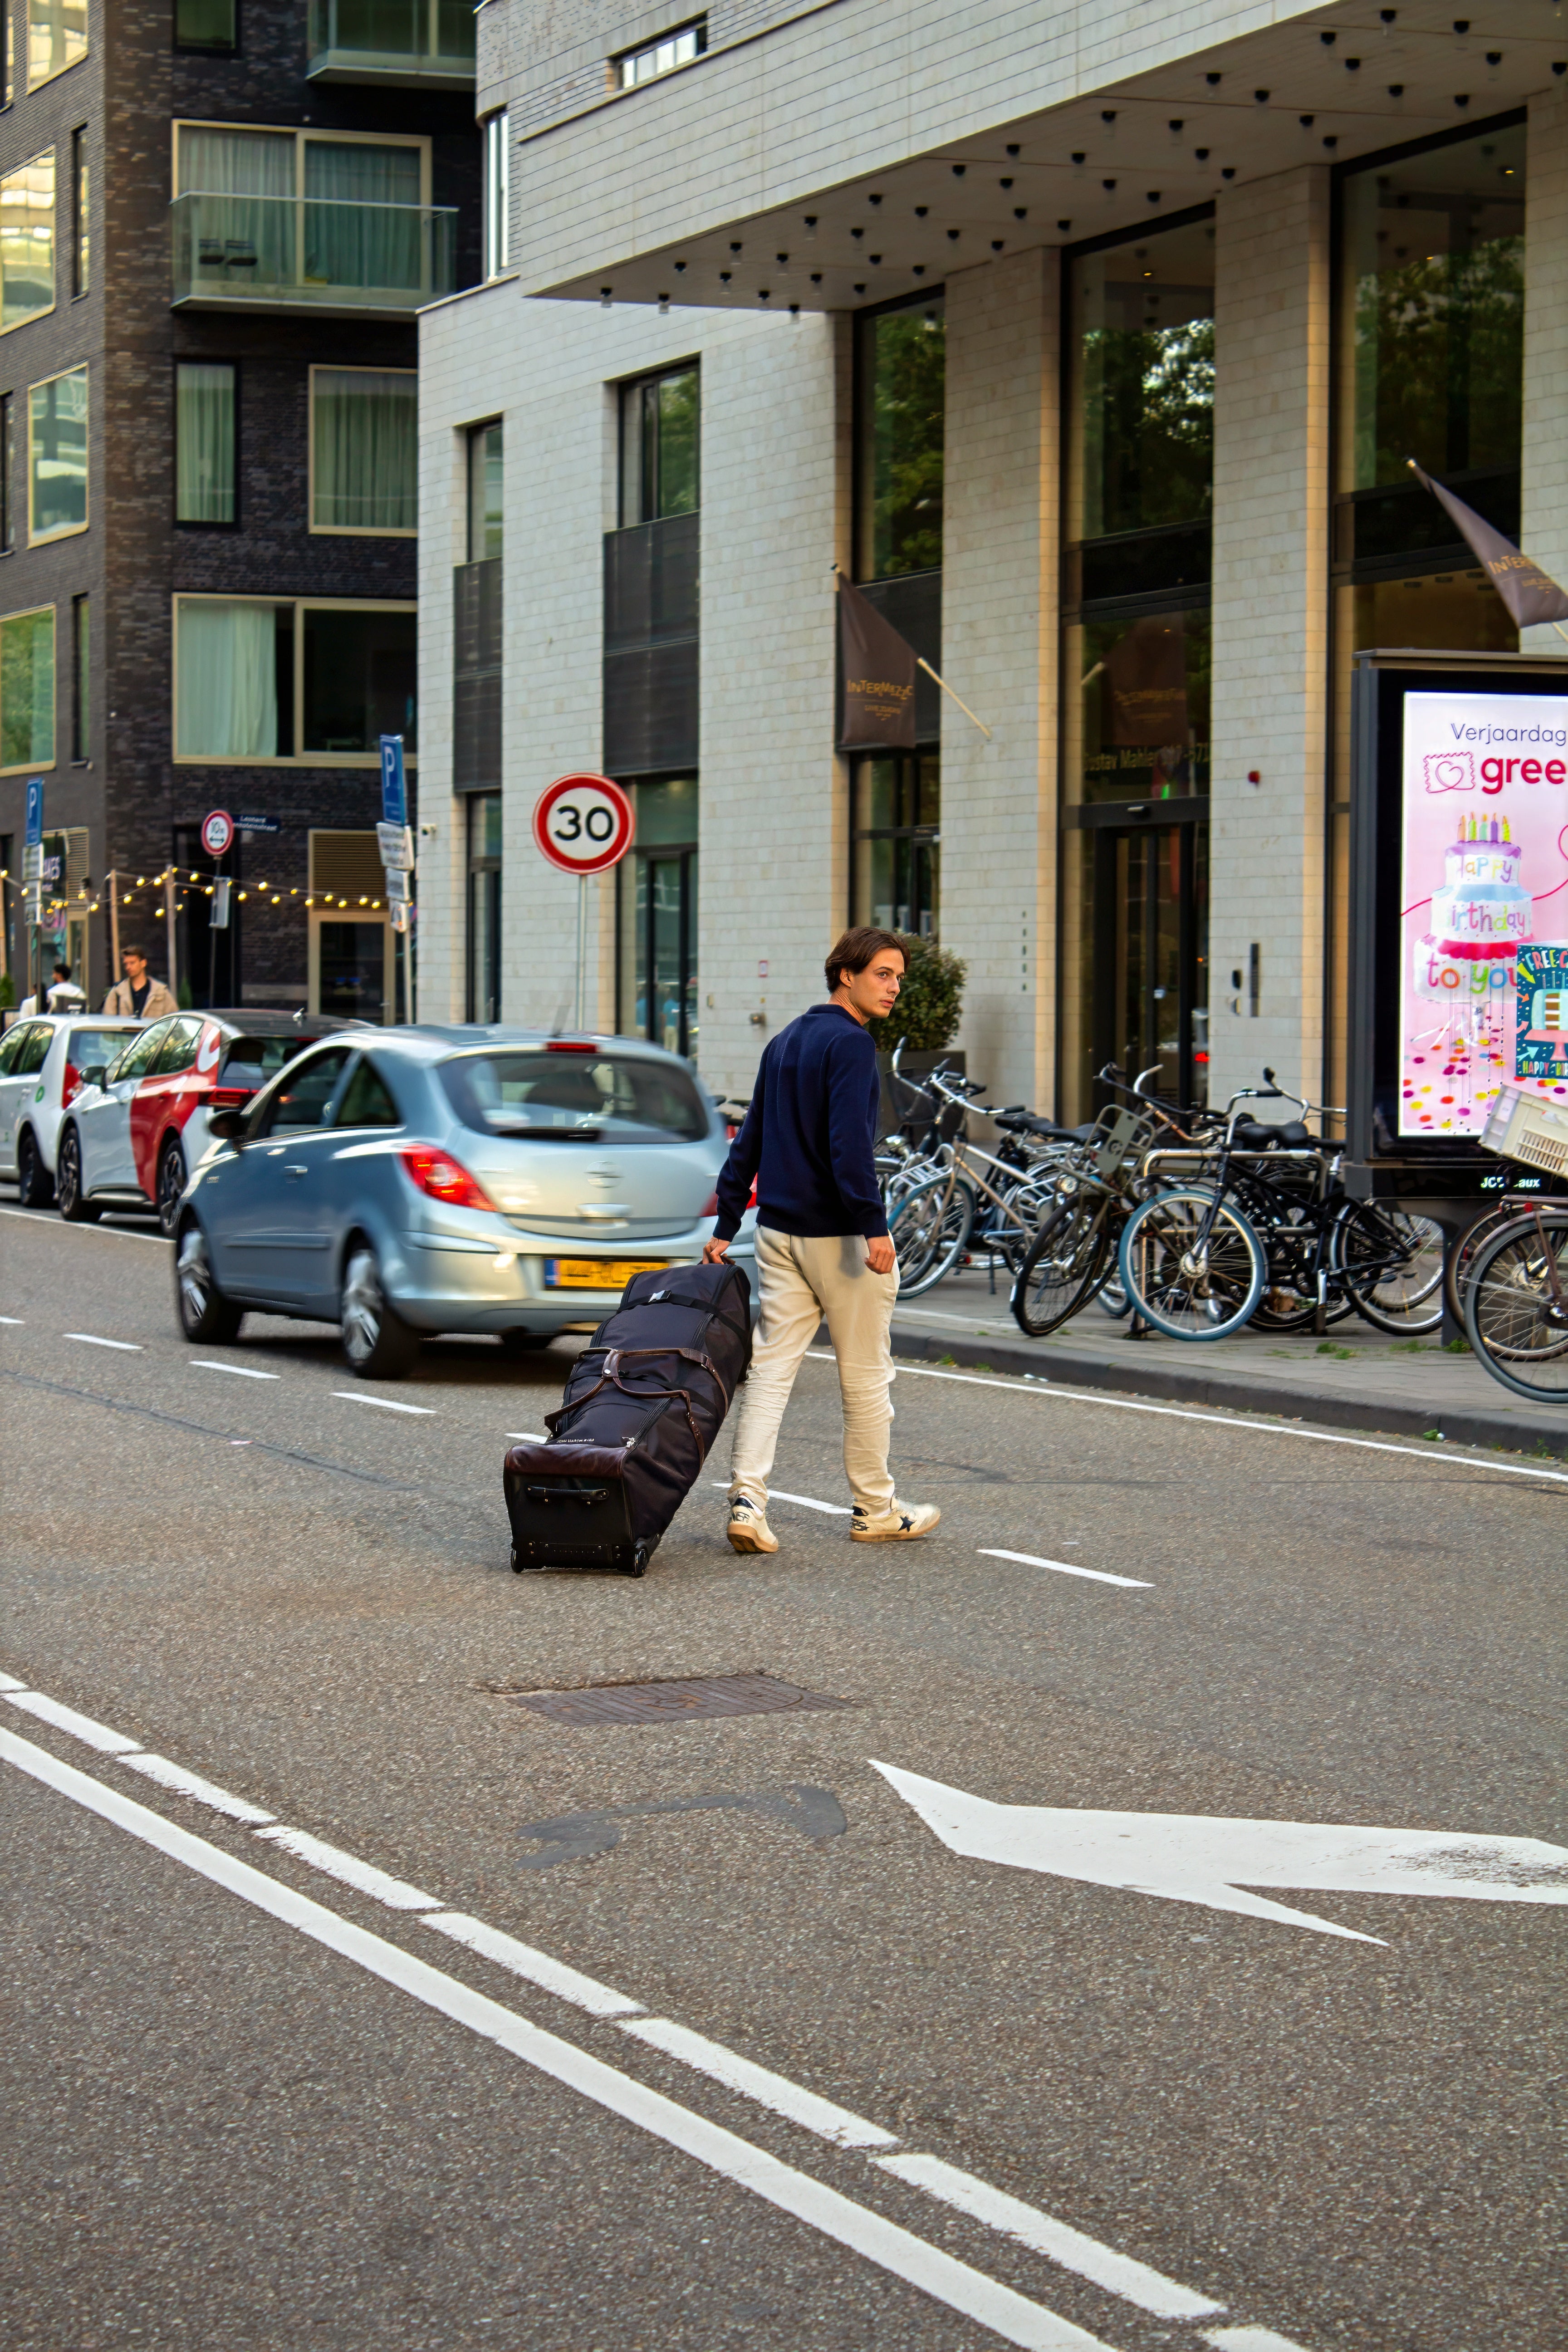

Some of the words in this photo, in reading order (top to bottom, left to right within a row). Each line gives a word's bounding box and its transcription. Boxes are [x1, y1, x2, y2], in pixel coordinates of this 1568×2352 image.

[1451, 723, 1567, 746] Verjaardag
[1481, 757, 1567, 795] gree
[554, 805, 613, 842] 30
[1446, 901, 1525, 937] irthday
[1427, 952, 1460, 990] to
[1525, 950, 1558, 971] FREE
[1559, 950, 1568, 969] C
[1523, 1060, 1550, 1075] HAPPY
